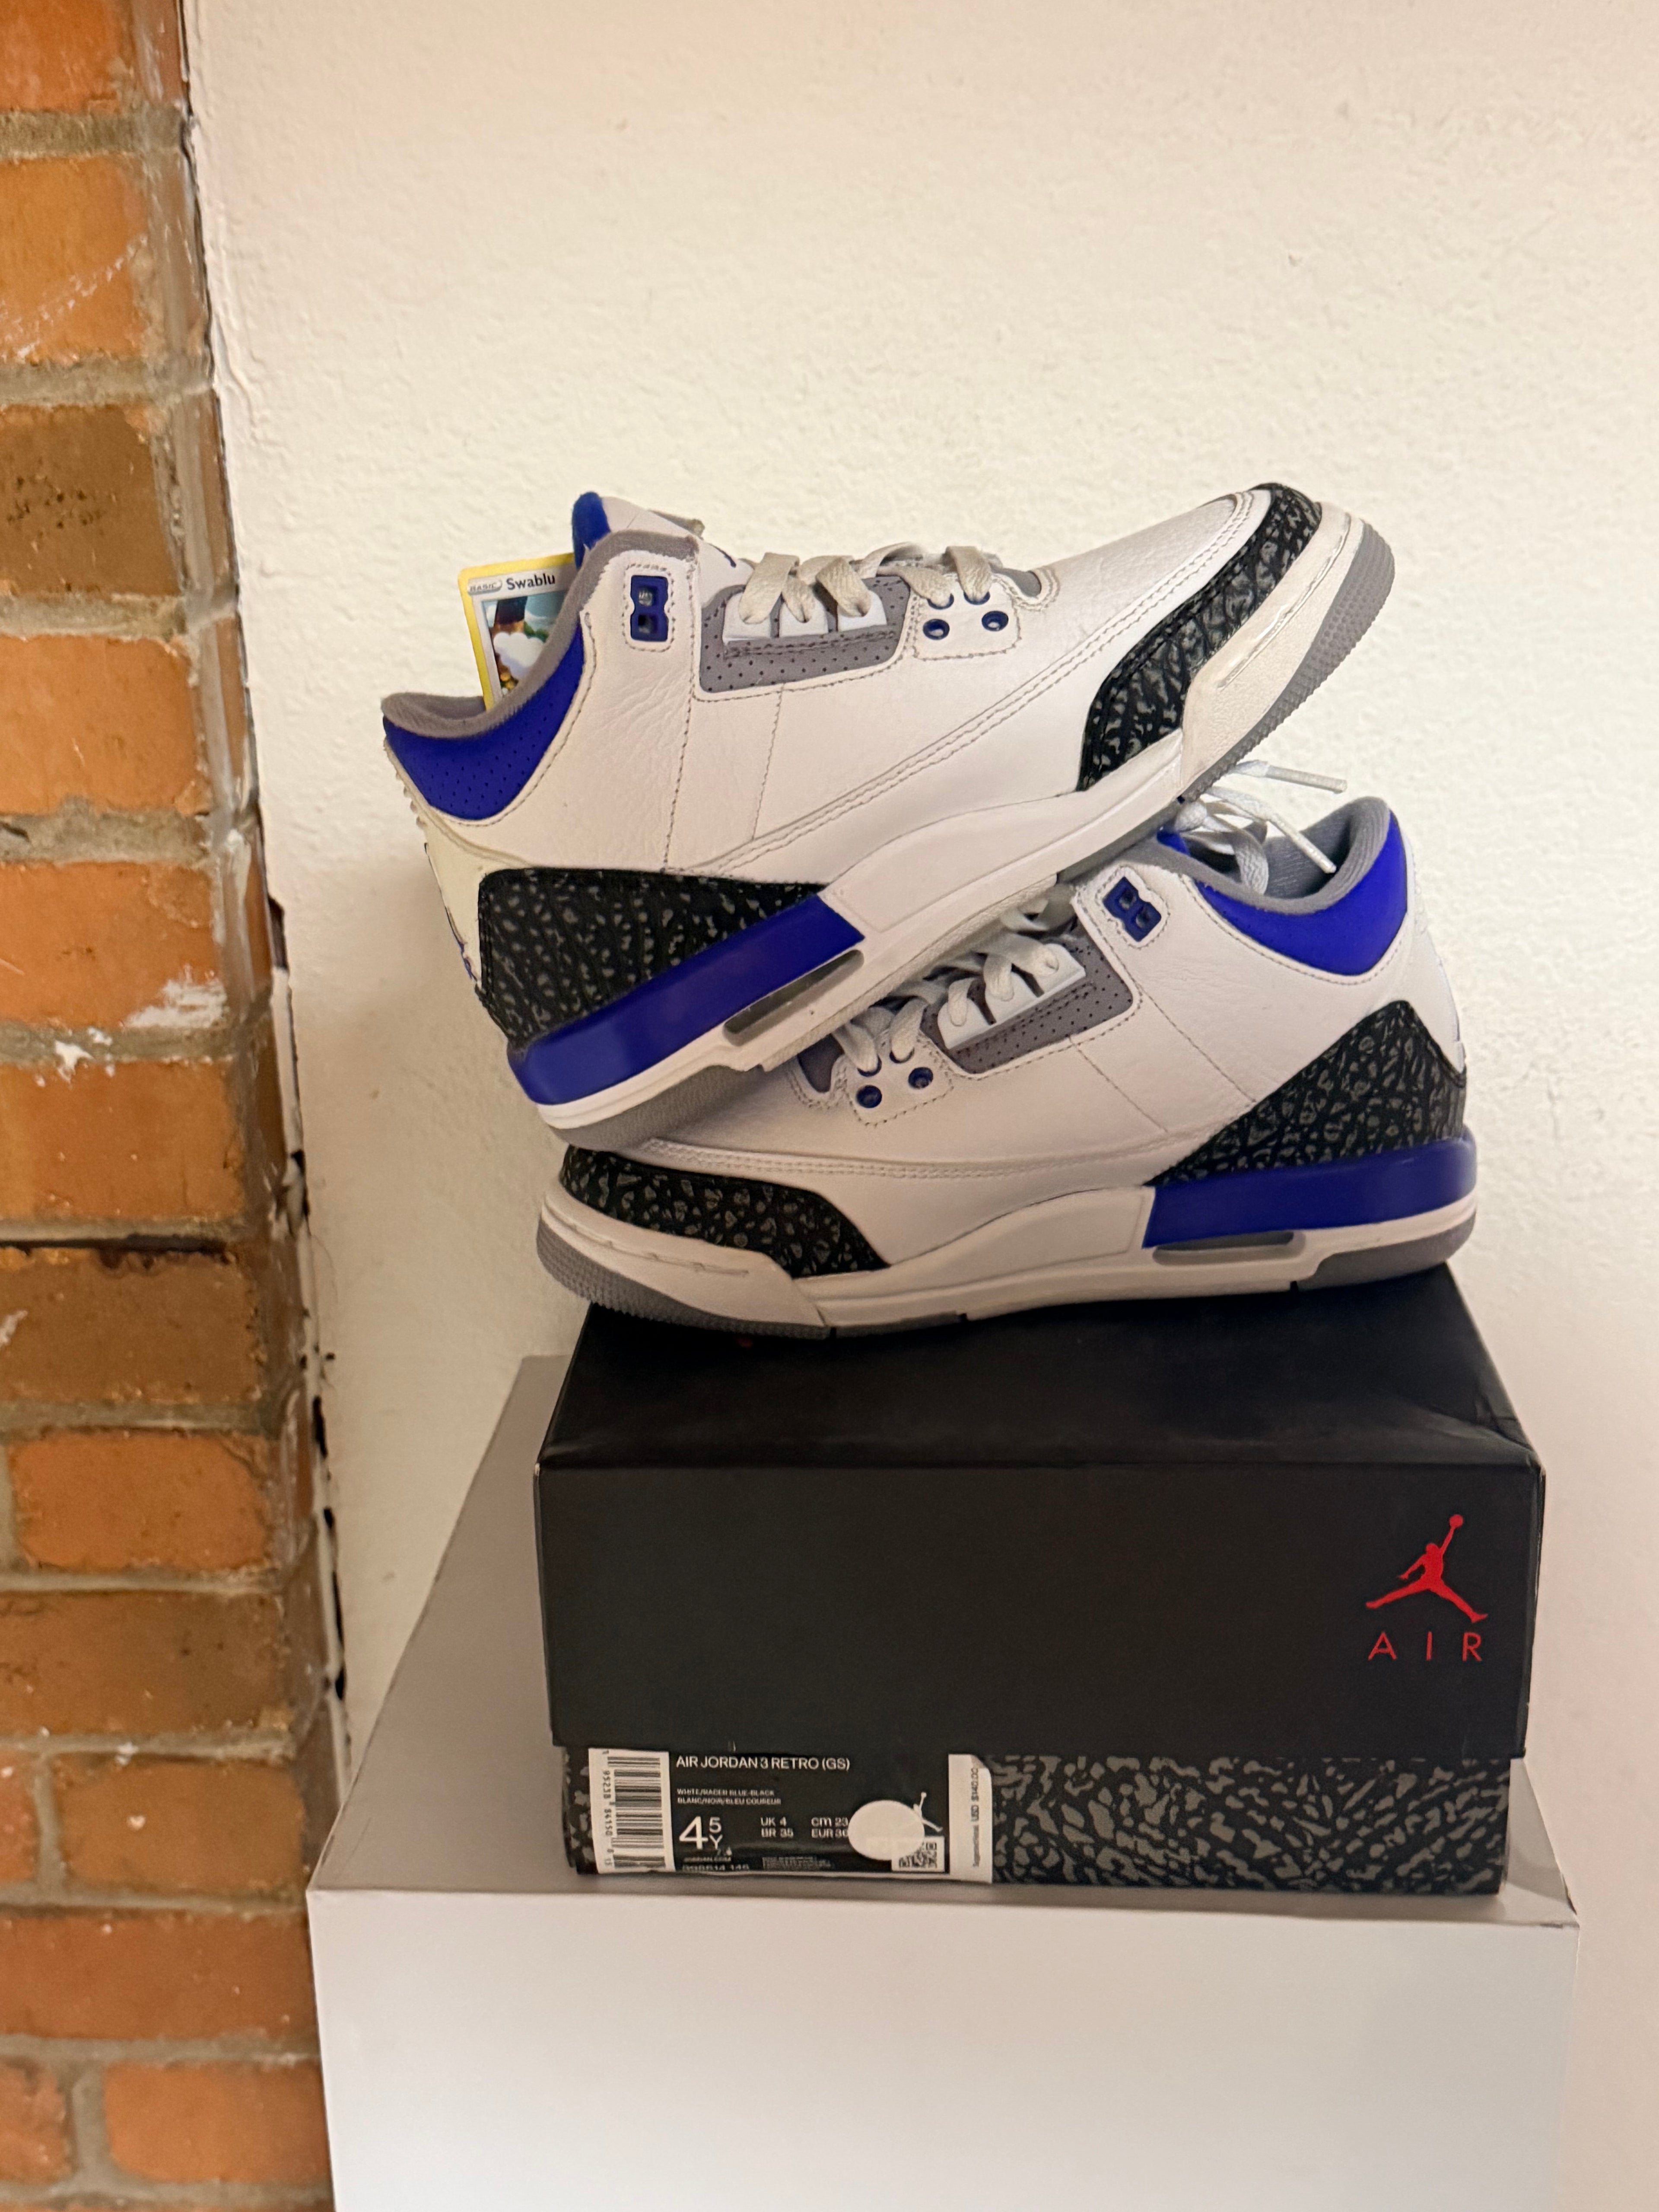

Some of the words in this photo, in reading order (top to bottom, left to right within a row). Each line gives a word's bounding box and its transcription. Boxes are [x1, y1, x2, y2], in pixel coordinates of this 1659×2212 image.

[506, 573, 556, 591] Swablu
[1368, 1631, 1482, 1661] AIR
[676, 1756, 698, 1767] AIR
[701, 1756, 758, 1768] JORDAN
[760, 1757, 769, 1769] 3
[771, 1757, 819, 1770] RETRO
[822, 1757, 850, 1771] (GS)
[760, 1817, 776, 1827] UK
[779, 1816, 787, 1827] 4
[811, 1817, 832, 1827] cm
[811, 1828, 833, 1838] EUR
